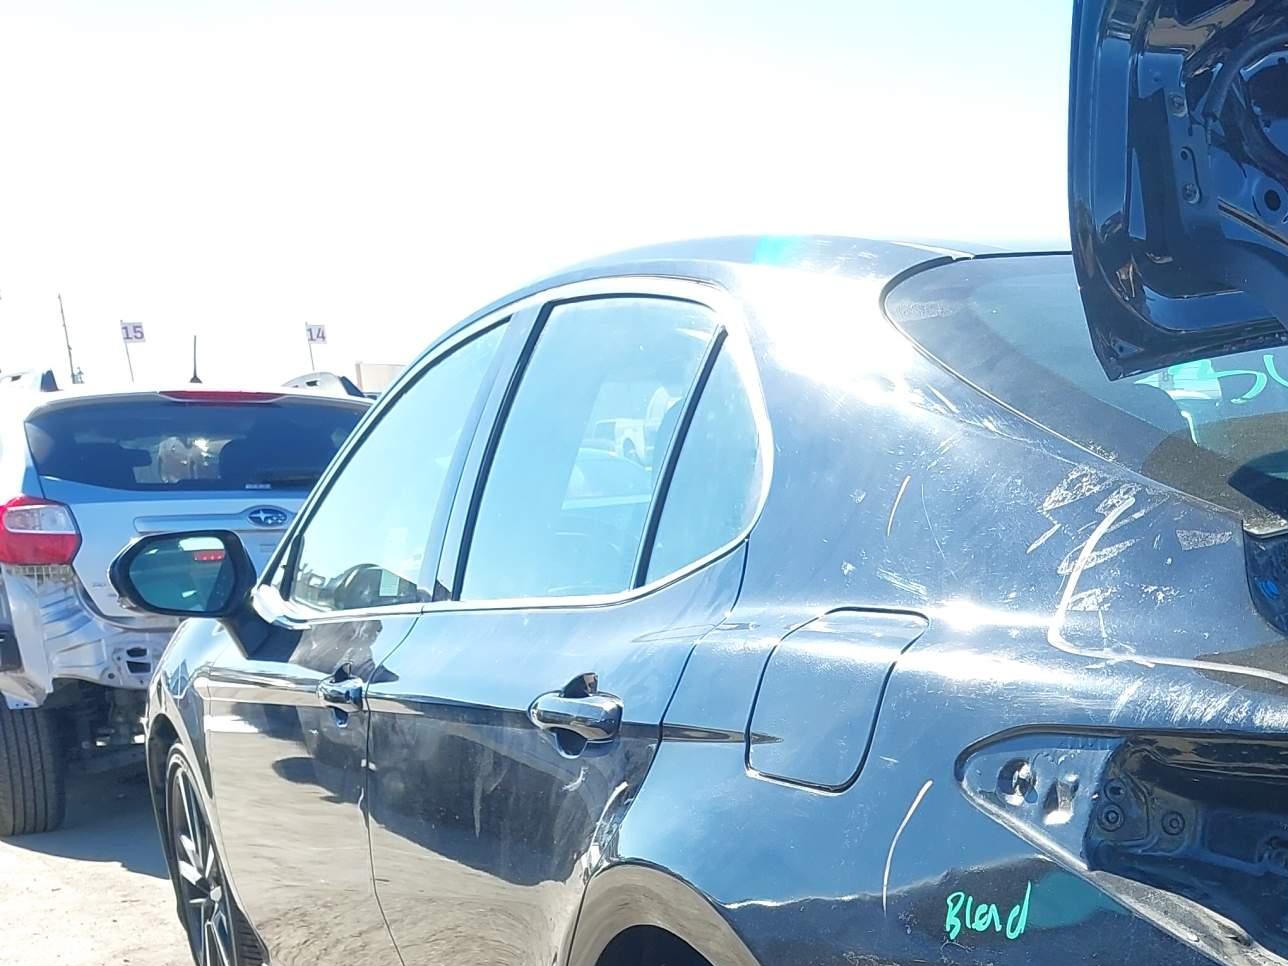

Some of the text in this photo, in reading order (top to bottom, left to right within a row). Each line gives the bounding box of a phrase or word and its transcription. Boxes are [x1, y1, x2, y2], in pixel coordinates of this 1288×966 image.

[121, 324, 146, 341] 15
[305, 327, 327, 342] 14
[945, 880, 1032, 940] Blend
